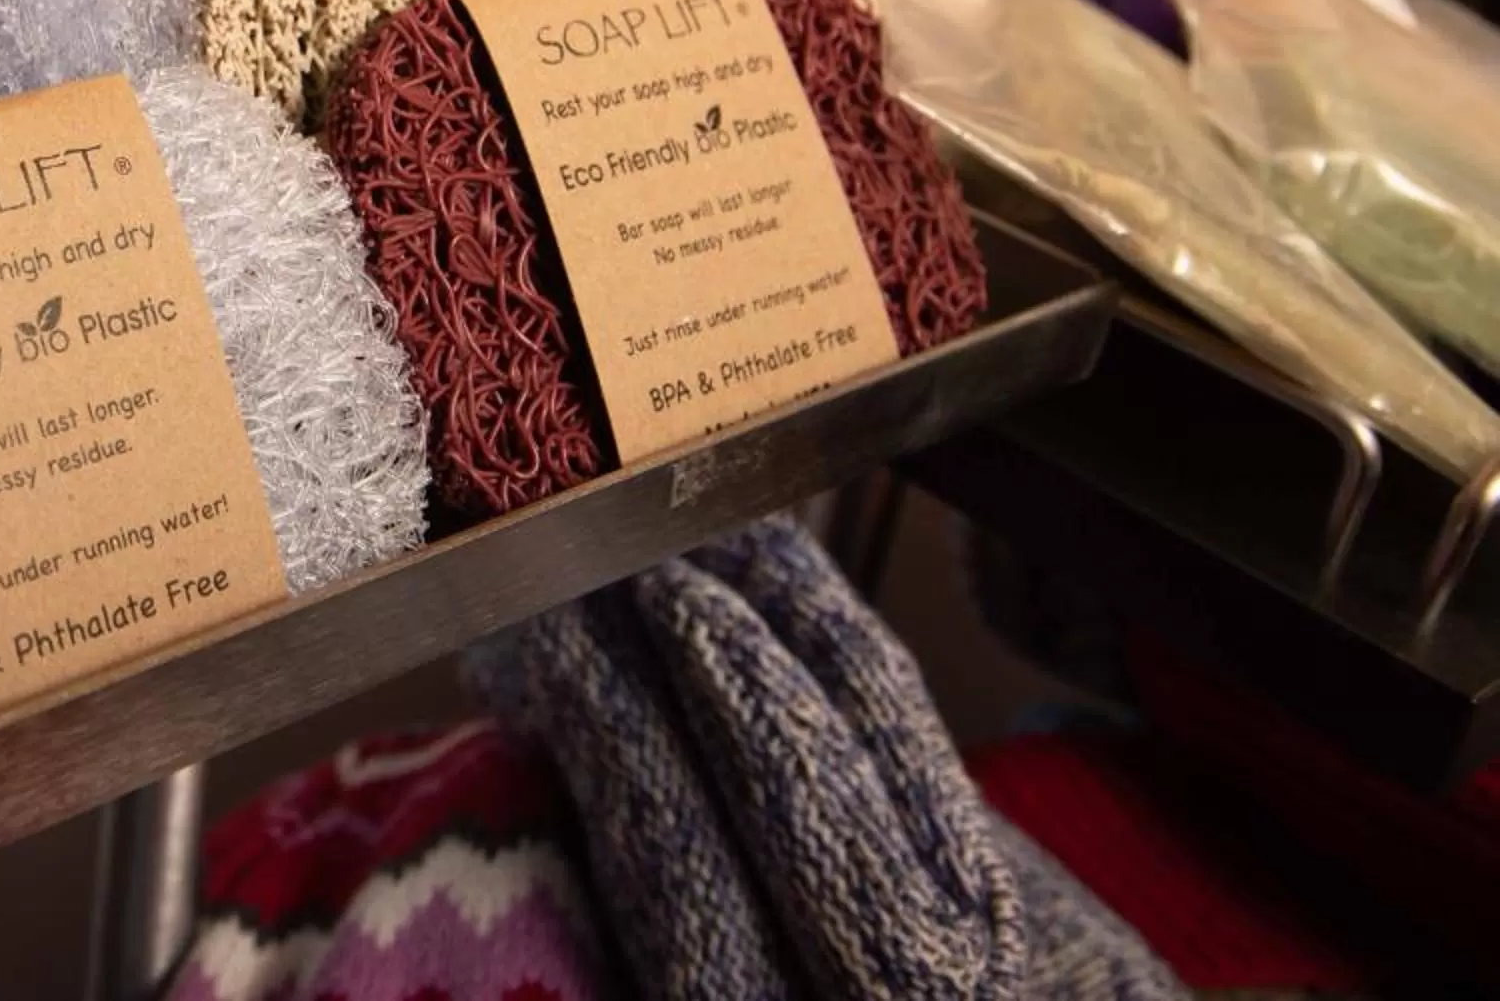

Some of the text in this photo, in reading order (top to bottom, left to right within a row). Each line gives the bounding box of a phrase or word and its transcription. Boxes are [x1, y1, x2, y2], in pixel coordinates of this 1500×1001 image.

[536, 7, 647, 66] SOAP
[541, 54, 774, 124] Rest your soap high and dry
[558, 108, 799, 191] Eco Friendly bio Plastic
[63, 231, 107, 264] and
[114, 221, 156, 251] dry
[617, 222, 645, 243] Bar
[649, 211, 685, 235] soap
[687, 199, 716, 221] will
[717, 192, 745, 213] last
[652, 247, 676, 266] No
[679, 233, 725, 259] messy
[14, 327, 70, 364] bio
[78, 296, 178, 344] Plastic
[622, 330, 659, 357] Just
[664, 318, 702, 343] rinse
[706, 302, 747, 328] under
[752, 283, 805, 312] running
[649, 379, 693, 413] BPA
[697, 370, 716, 396] &
[719, 339, 814, 388] Phthalate
[814, 324, 859, 352] Free
[37, 408, 78, 439] last
[87, 387, 160, 422] longer.
[46, 436, 133, 476] residue.
[72, 524, 155, 564] running
[160, 494, 229, 534] water!
[13, 596, 157, 666] Phthalate
[164, 568, 230, 610] Free
